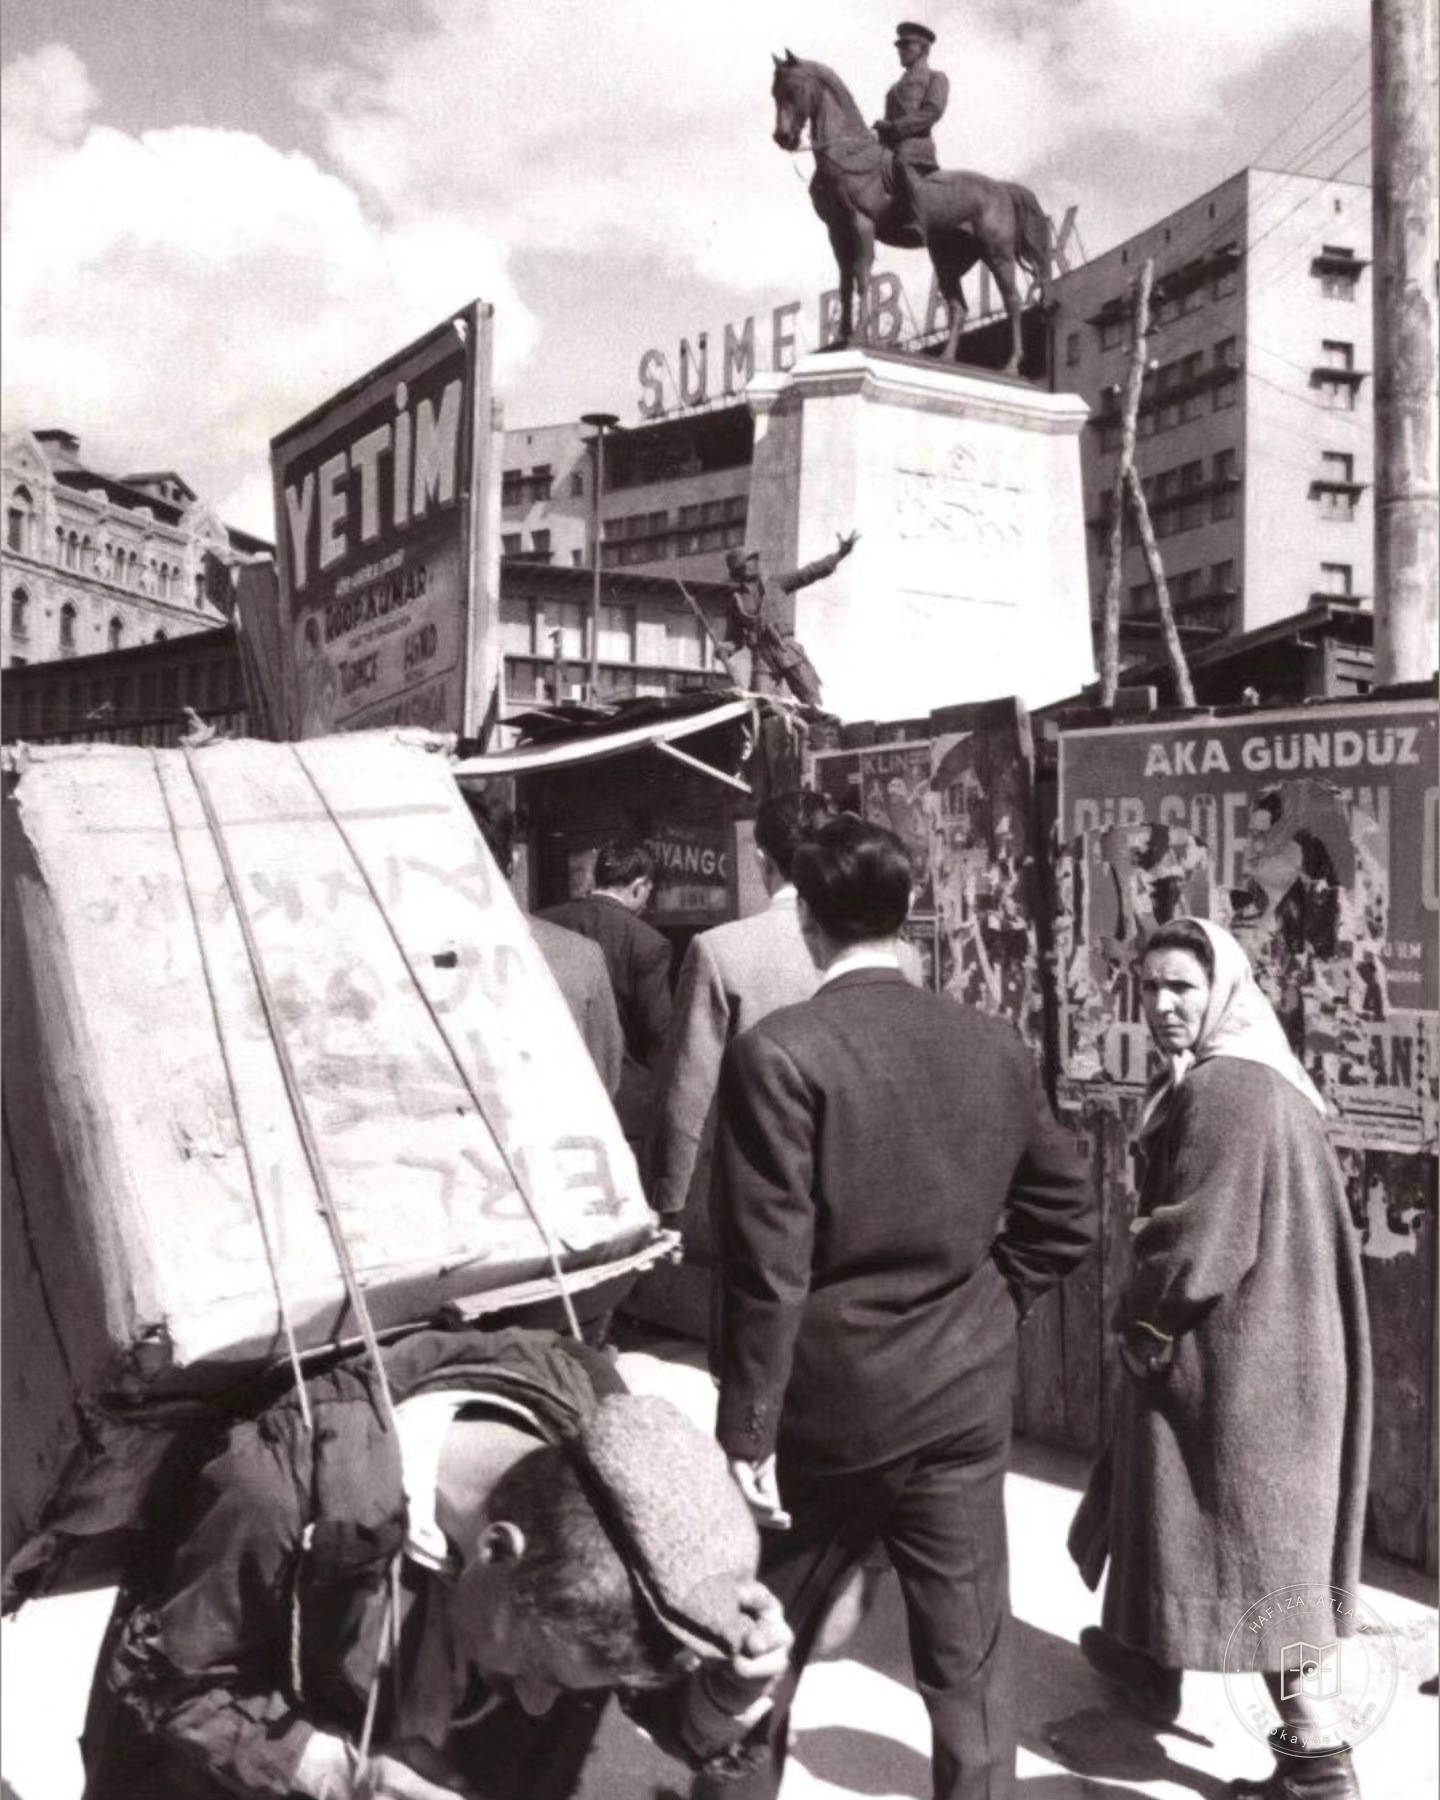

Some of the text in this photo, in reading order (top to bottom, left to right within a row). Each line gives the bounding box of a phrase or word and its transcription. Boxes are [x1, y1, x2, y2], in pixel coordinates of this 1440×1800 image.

[285, 378, 463, 591] YETİM
[1143, 727, 1420, 777] AKA GÜNDÜZ
